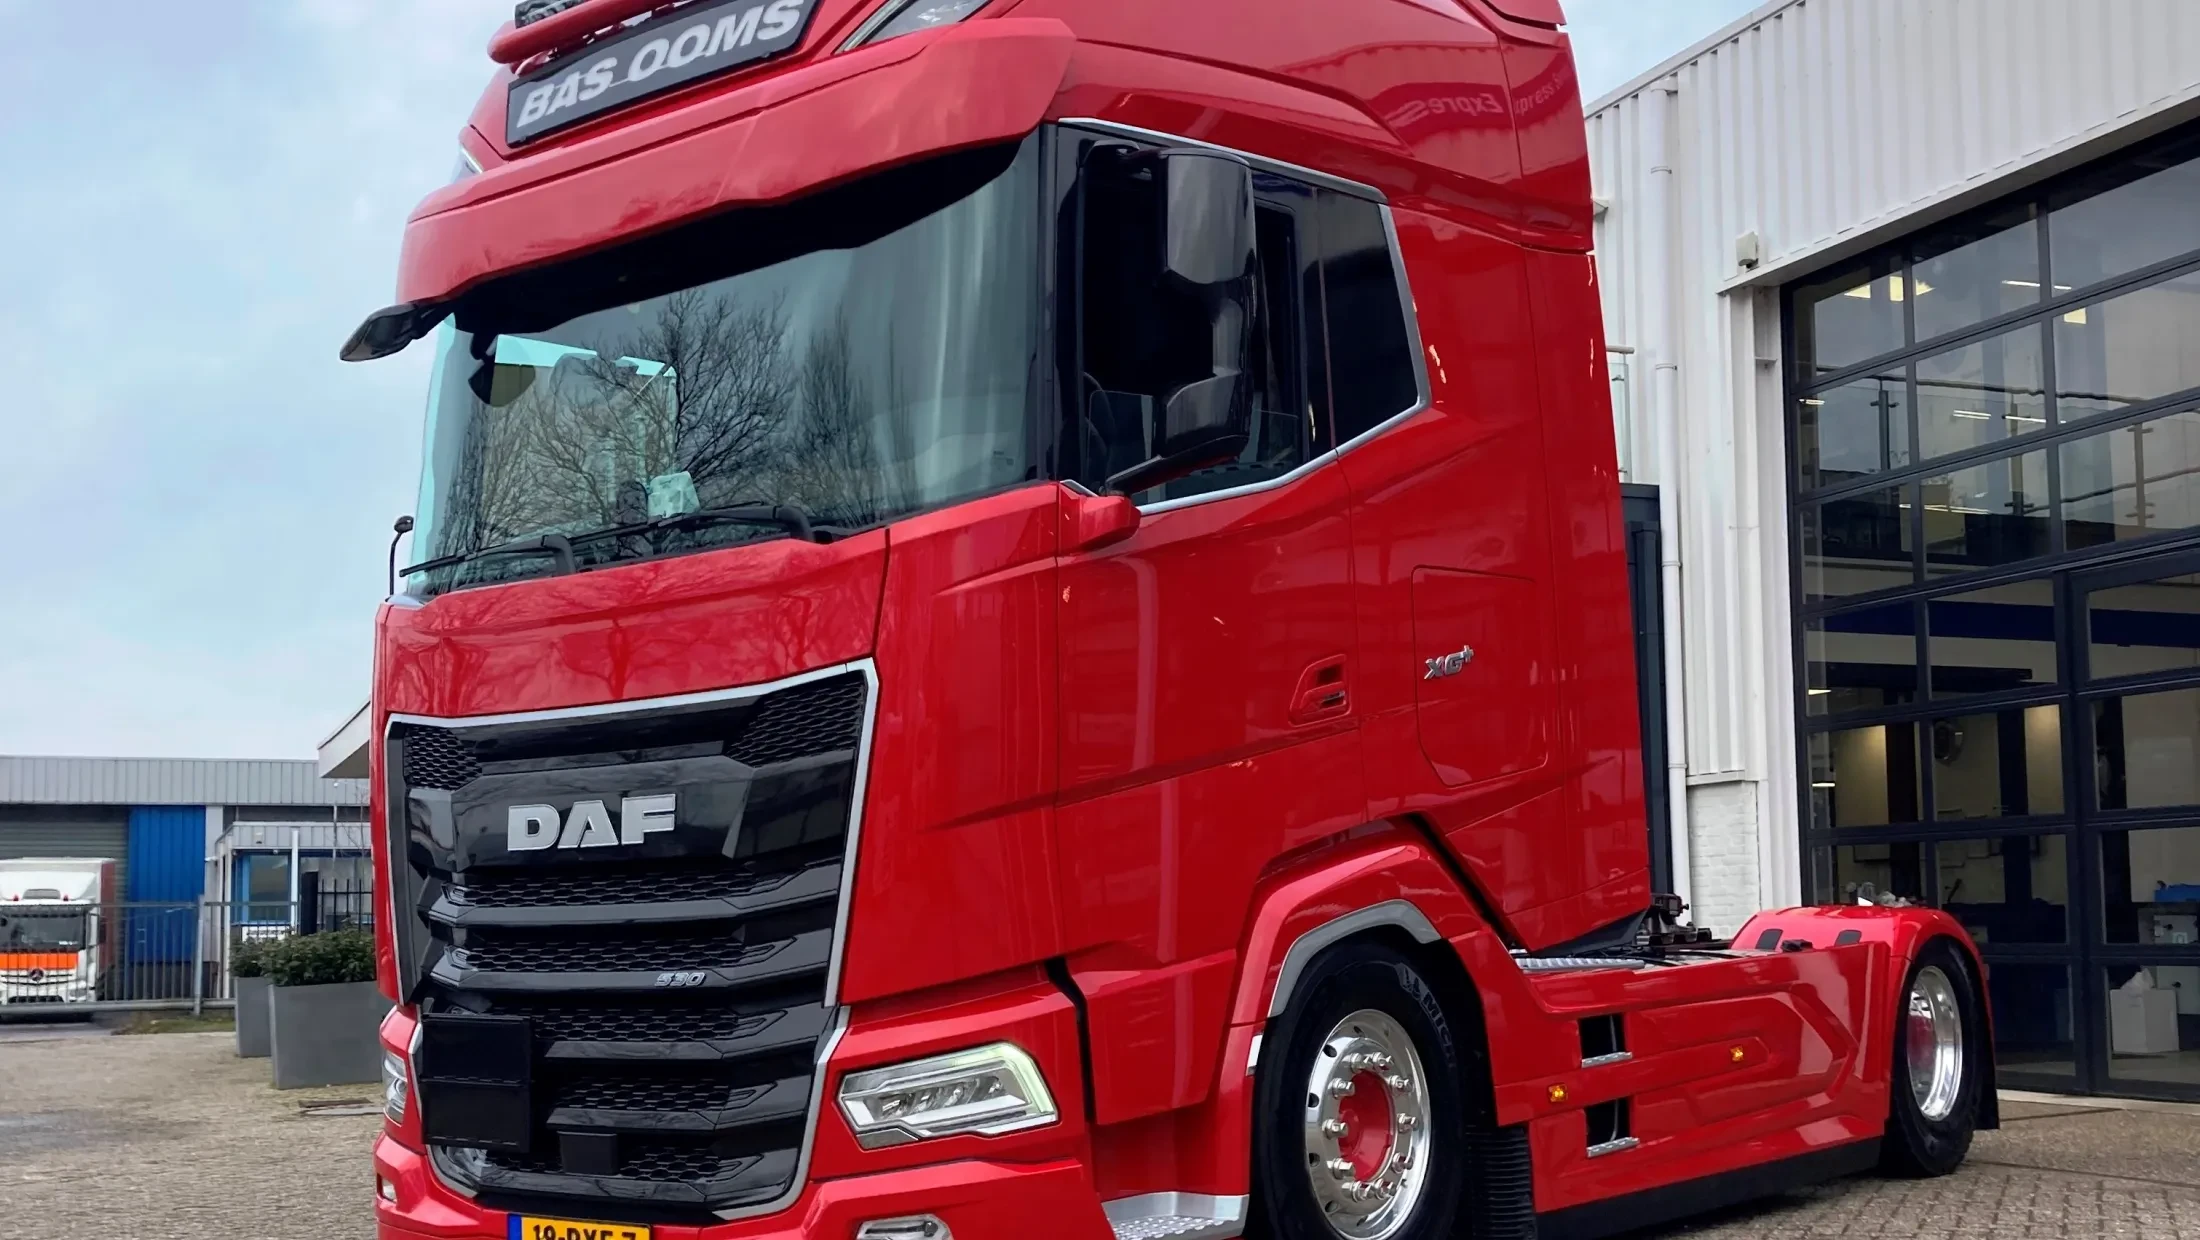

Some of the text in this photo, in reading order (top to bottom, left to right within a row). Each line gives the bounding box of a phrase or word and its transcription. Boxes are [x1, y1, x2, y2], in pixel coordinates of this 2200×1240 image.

[516, 0, 801, 129] BAS OOMS
[507, 793, 677, 852] DAF
[653, 971, 707, 987] 530
